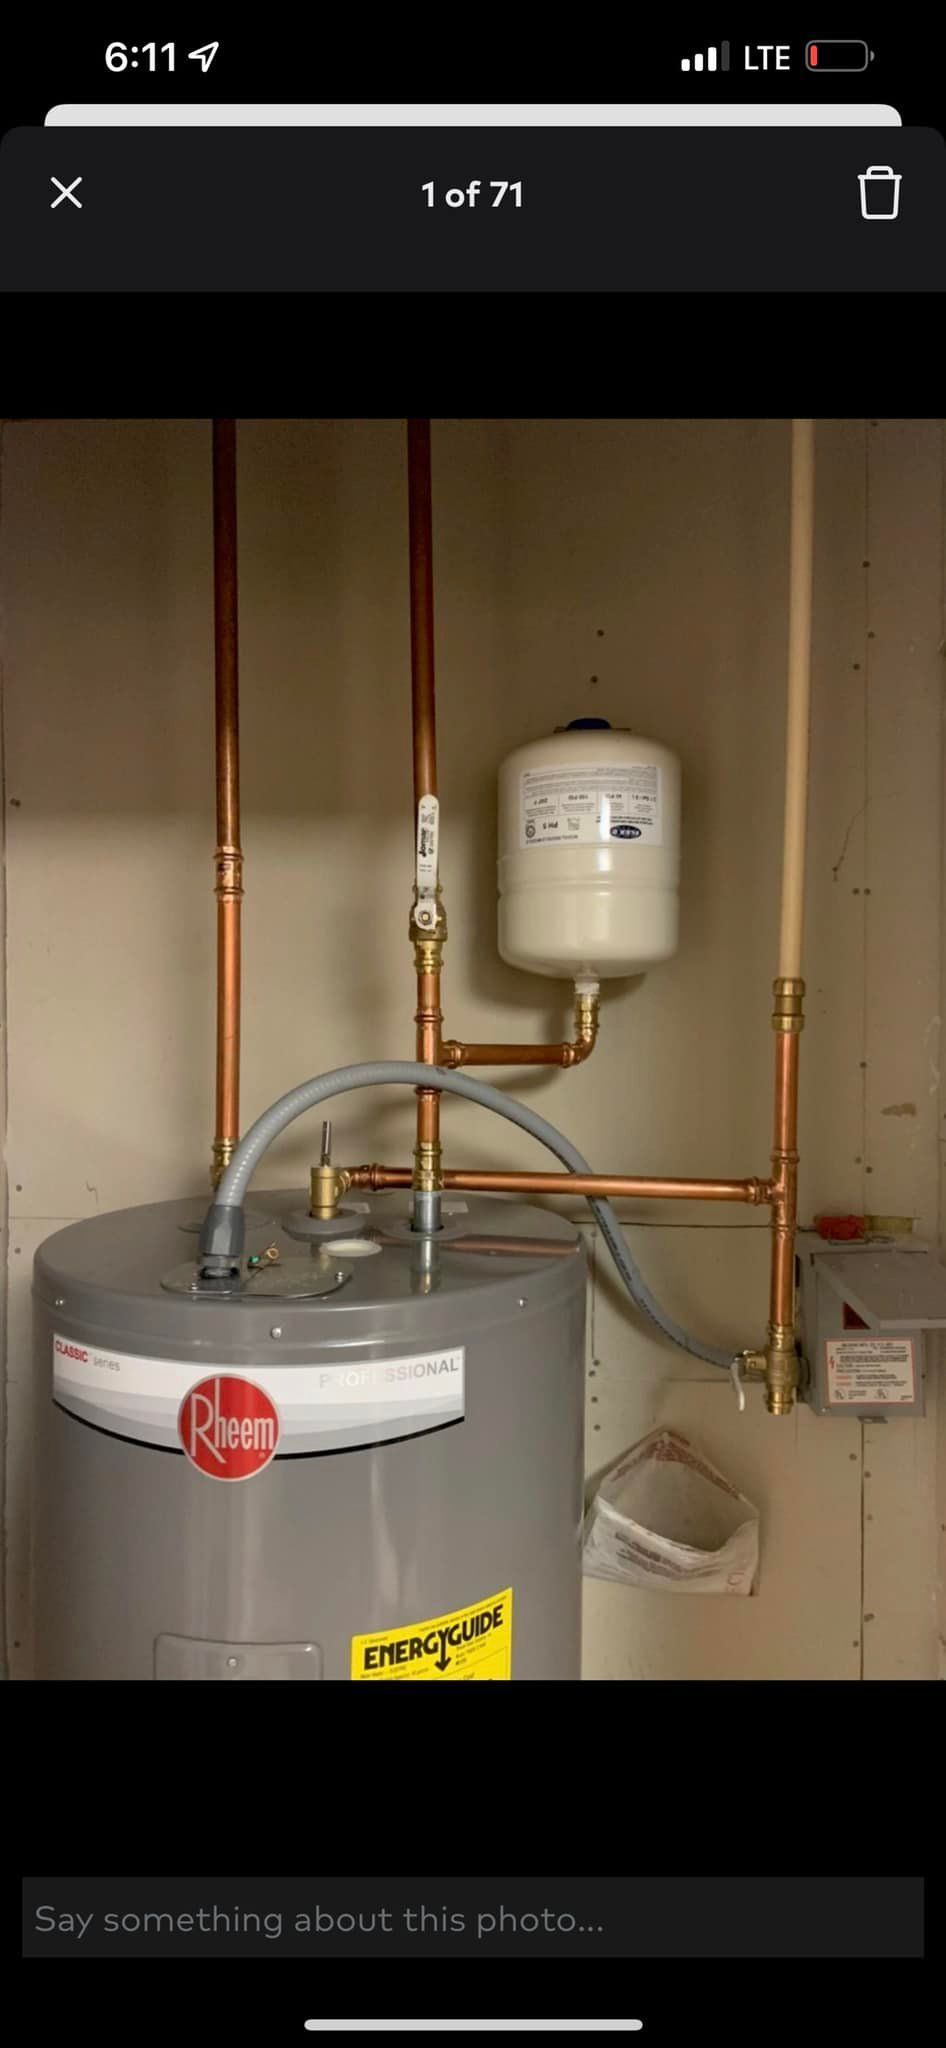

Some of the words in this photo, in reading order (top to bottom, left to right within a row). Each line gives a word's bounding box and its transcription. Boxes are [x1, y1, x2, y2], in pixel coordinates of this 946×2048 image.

[55, 1340, 89, 1363] CLASSIC
[93, 1355, 121, 1372] series
[190, 1377, 275, 1464] Rheem
[363, 1603, 504, 1672] ENERGYGUIDE
